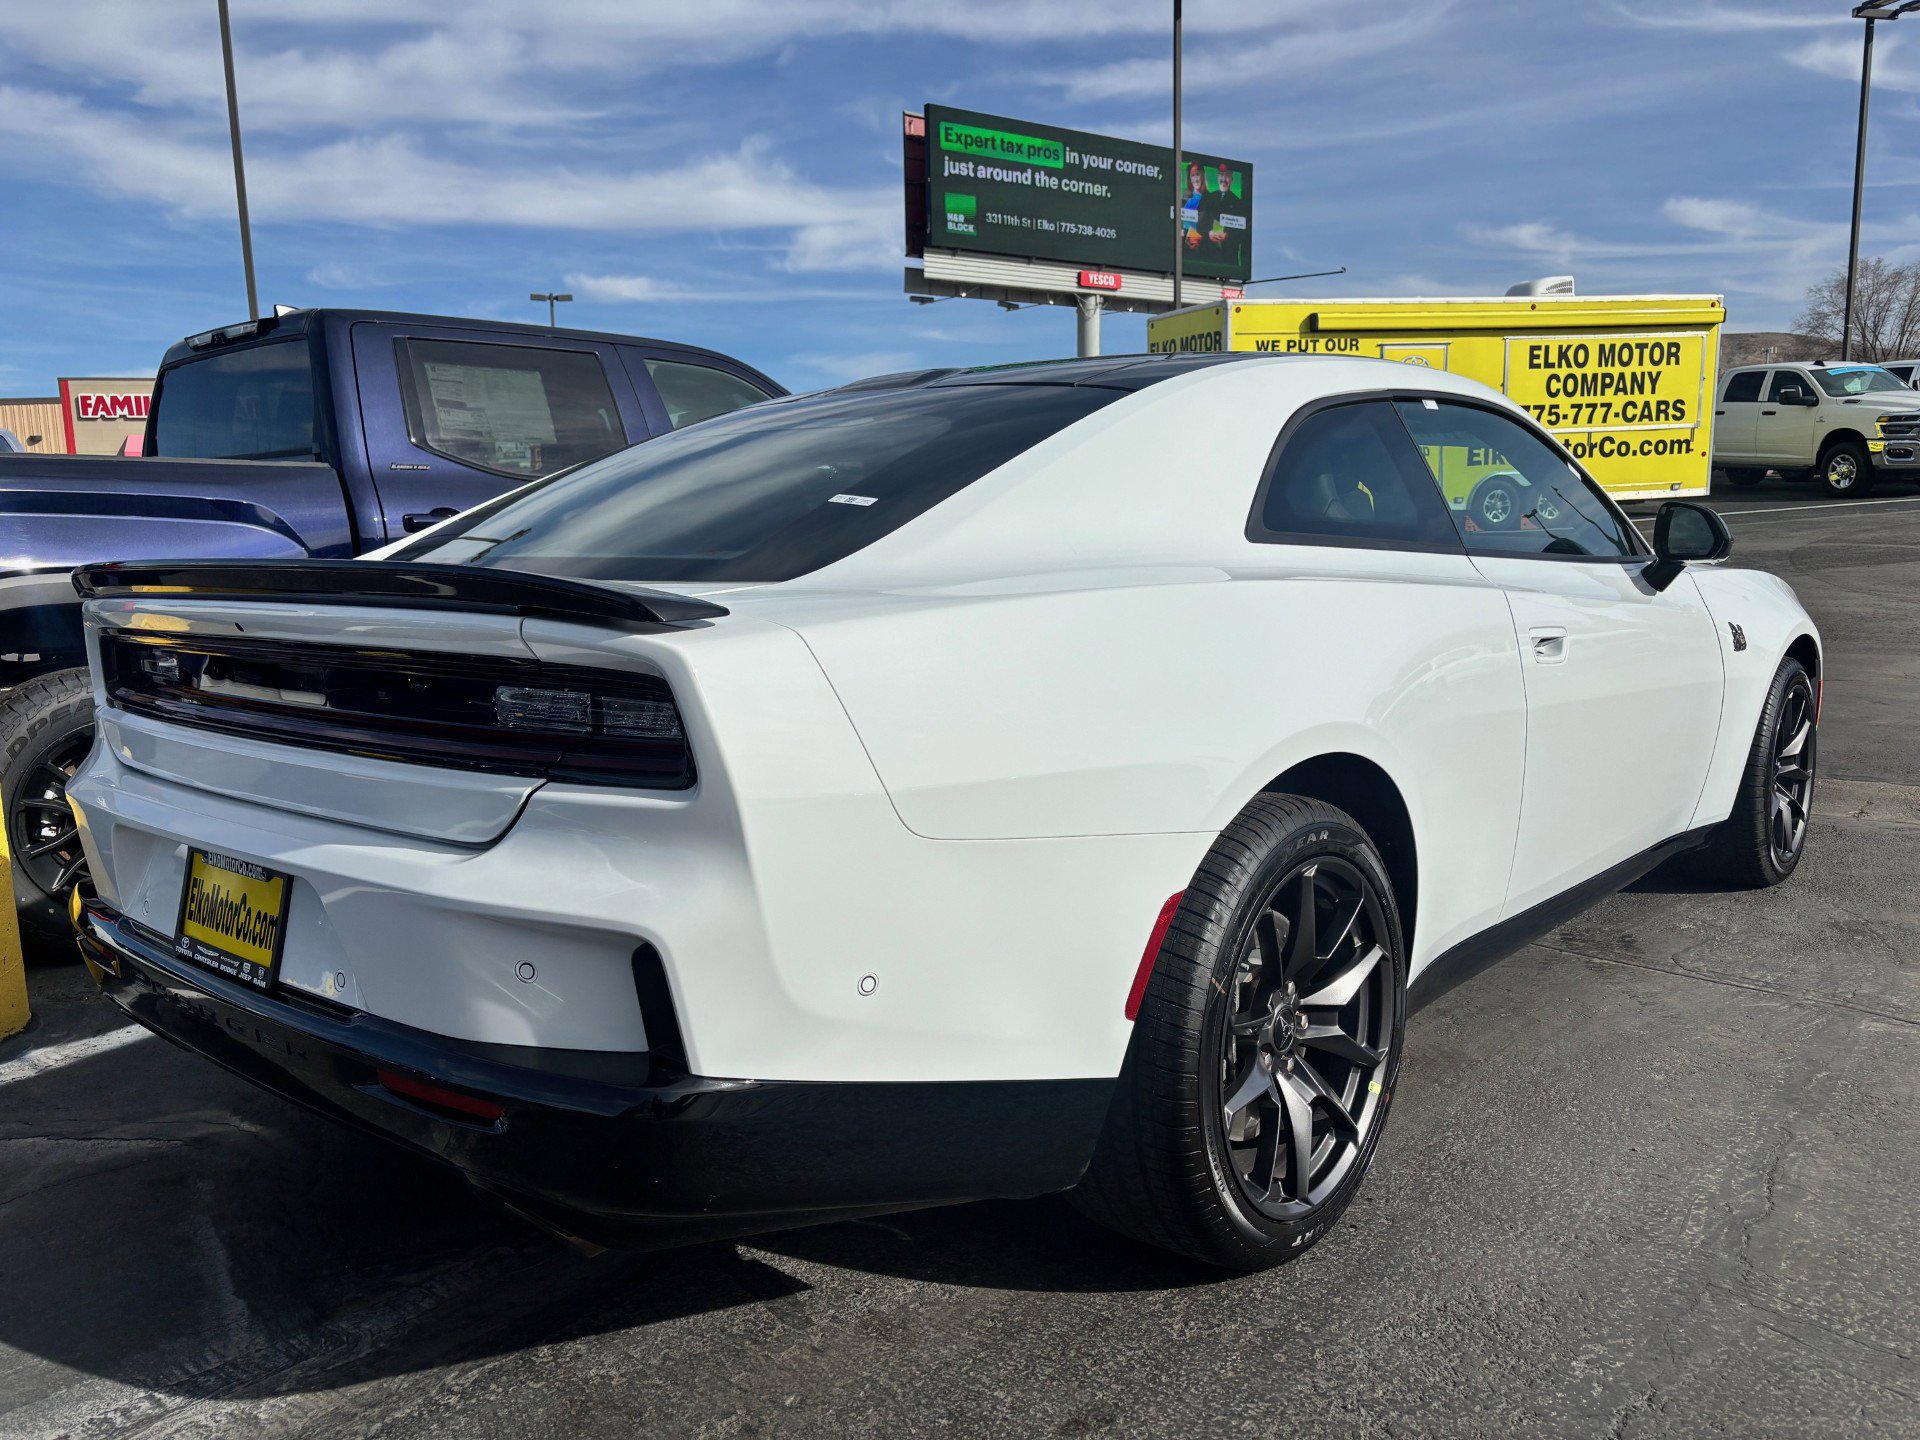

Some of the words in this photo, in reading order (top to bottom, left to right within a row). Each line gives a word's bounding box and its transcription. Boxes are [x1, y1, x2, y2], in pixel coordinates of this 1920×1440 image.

[944, 126, 997, 151] Expert
[1000, 137, 1024, 155] tax
[1027, 144, 1060, 161] pros
[1065, 146, 1080, 164] in
[1081, 153, 1114, 170] your
[1115, 159, 1163, 180] corner,
[943, 155, 975, 177] just
[976, 165, 1032, 186] around
[1034, 170, 1059, 189] the
[1061, 178, 1111, 198] corner.
[946, 212, 965, 223] H&R
[947, 222, 975, 233] BLOCK
[985, 212, 1002, 225] 331
[1003, 214, 1021, 228] 11th
[1021, 217, 1031, 229] St
[1037, 219, 1056, 232] Elko
[1060, 221, 1117, 239] 775-738-4026
[1088, 272, 1115, 286] YESCO
[1180, 330, 1222, 352] MOTOR
[1255, 339, 1281, 352] WE
[1286, 338, 1320, 352] PUT
[1324, 337, 1360, 352] OUR
[1528, 343, 1590, 370] ELKO
[1597, 341, 1681, 368] MOTOR
[1545, 370, 1662, 398] COMPANY
[187, 876, 279, 951] ElkoMotorCo.com
[175, 945, 193, 957] TOYOTA
[194, 953, 219, 969] CHRYSLER
[220, 963, 237, 976] DODGE
[238, 972, 252, 982] JEEP
[253, 977, 266, 988] RAM
